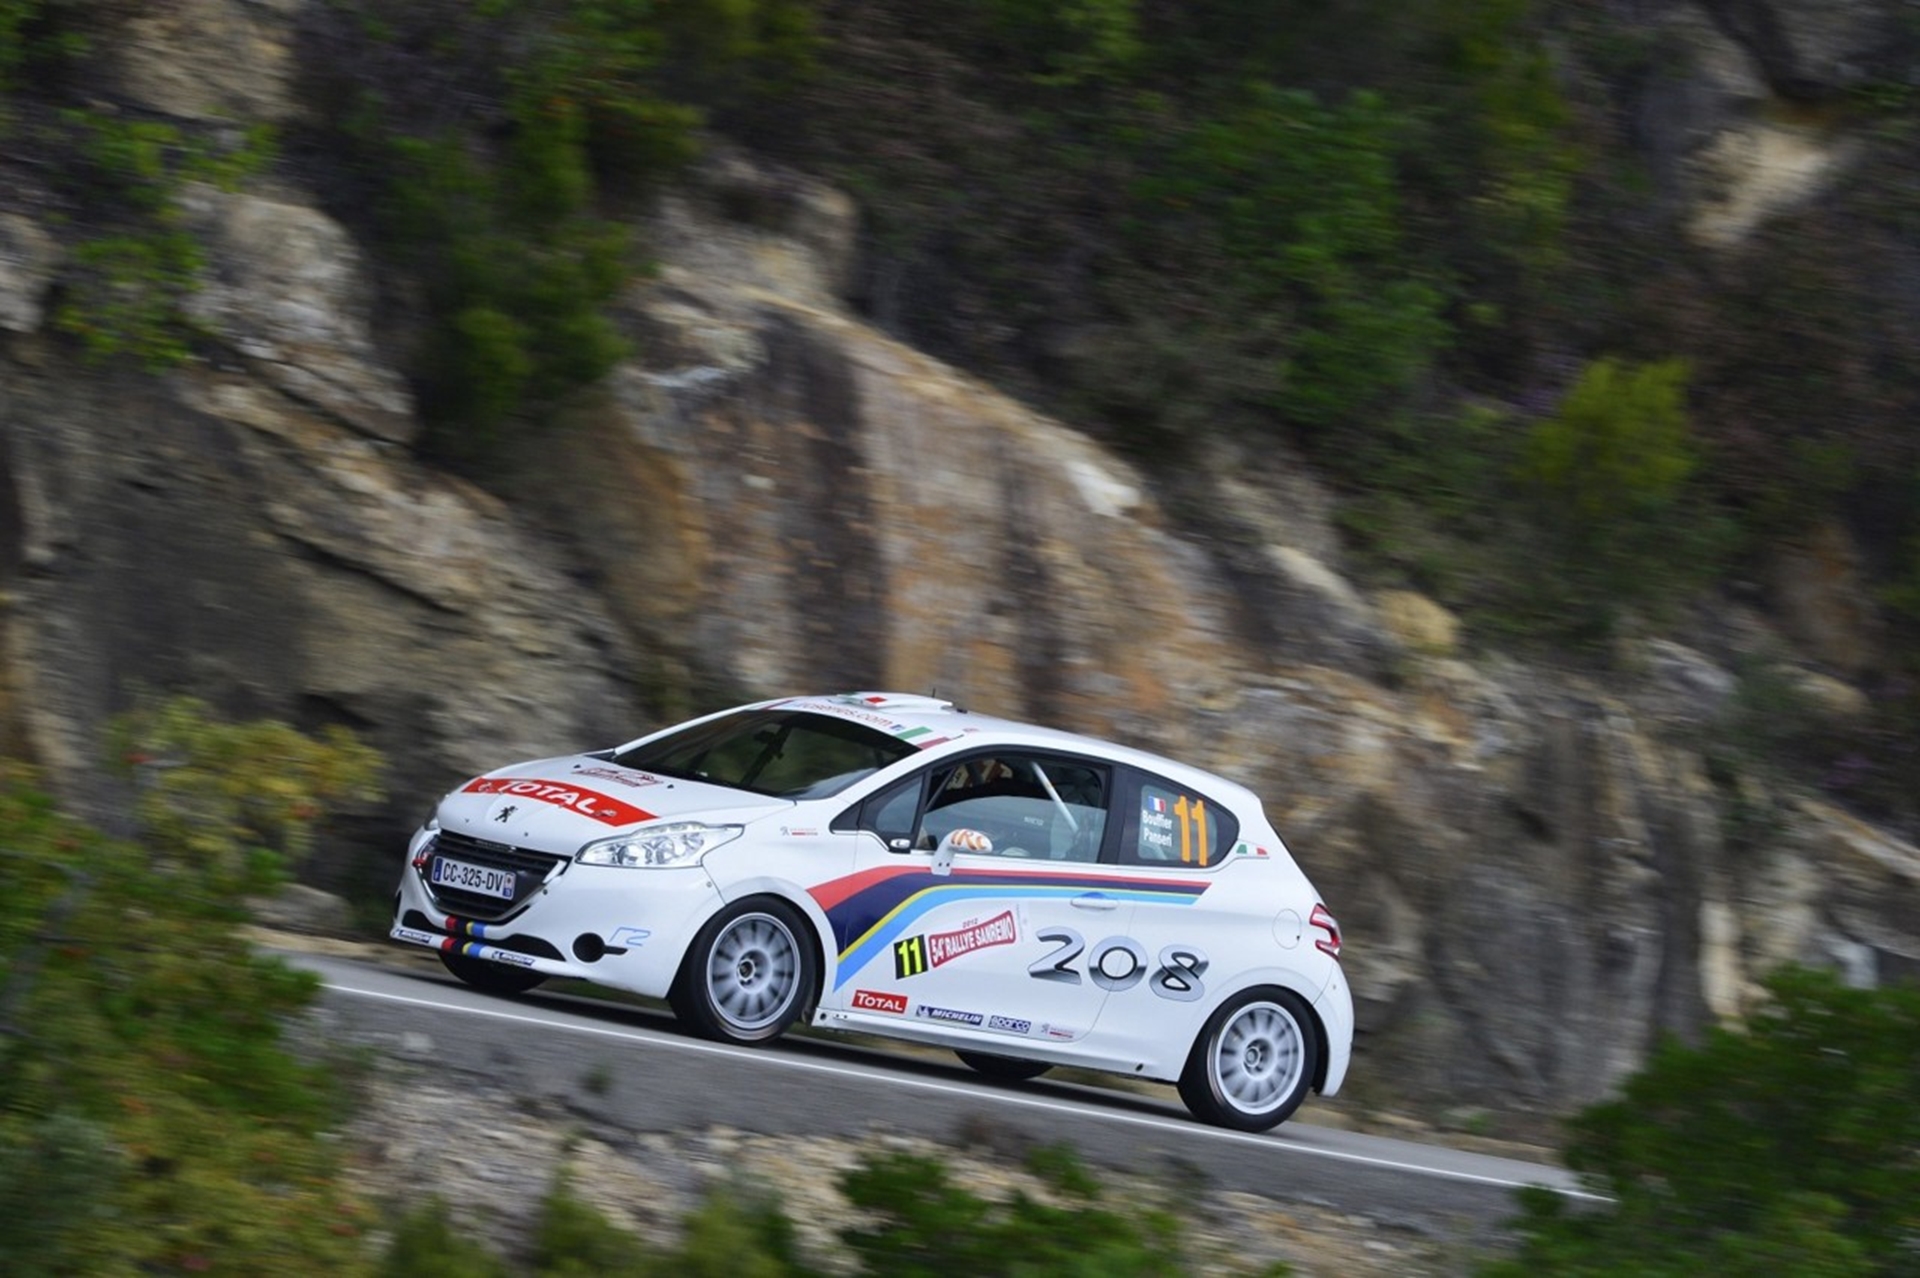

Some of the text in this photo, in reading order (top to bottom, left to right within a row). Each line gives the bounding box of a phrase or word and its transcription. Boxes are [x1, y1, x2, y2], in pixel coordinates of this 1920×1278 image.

[498, 780, 597, 815] TOTAL
[1173, 795, 1207, 867] 11
[443, 862, 503, 892] CC-325-DV
[946, 931, 976, 959] RALLYE
[975, 914, 1013, 944] SANREMO
[898, 936, 923, 977] 11
[1027, 925, 1210, 1003] 208
[857, 992, 904, 1012] TOTAL
[931, 1008, 982, 1024] MICHELIN
